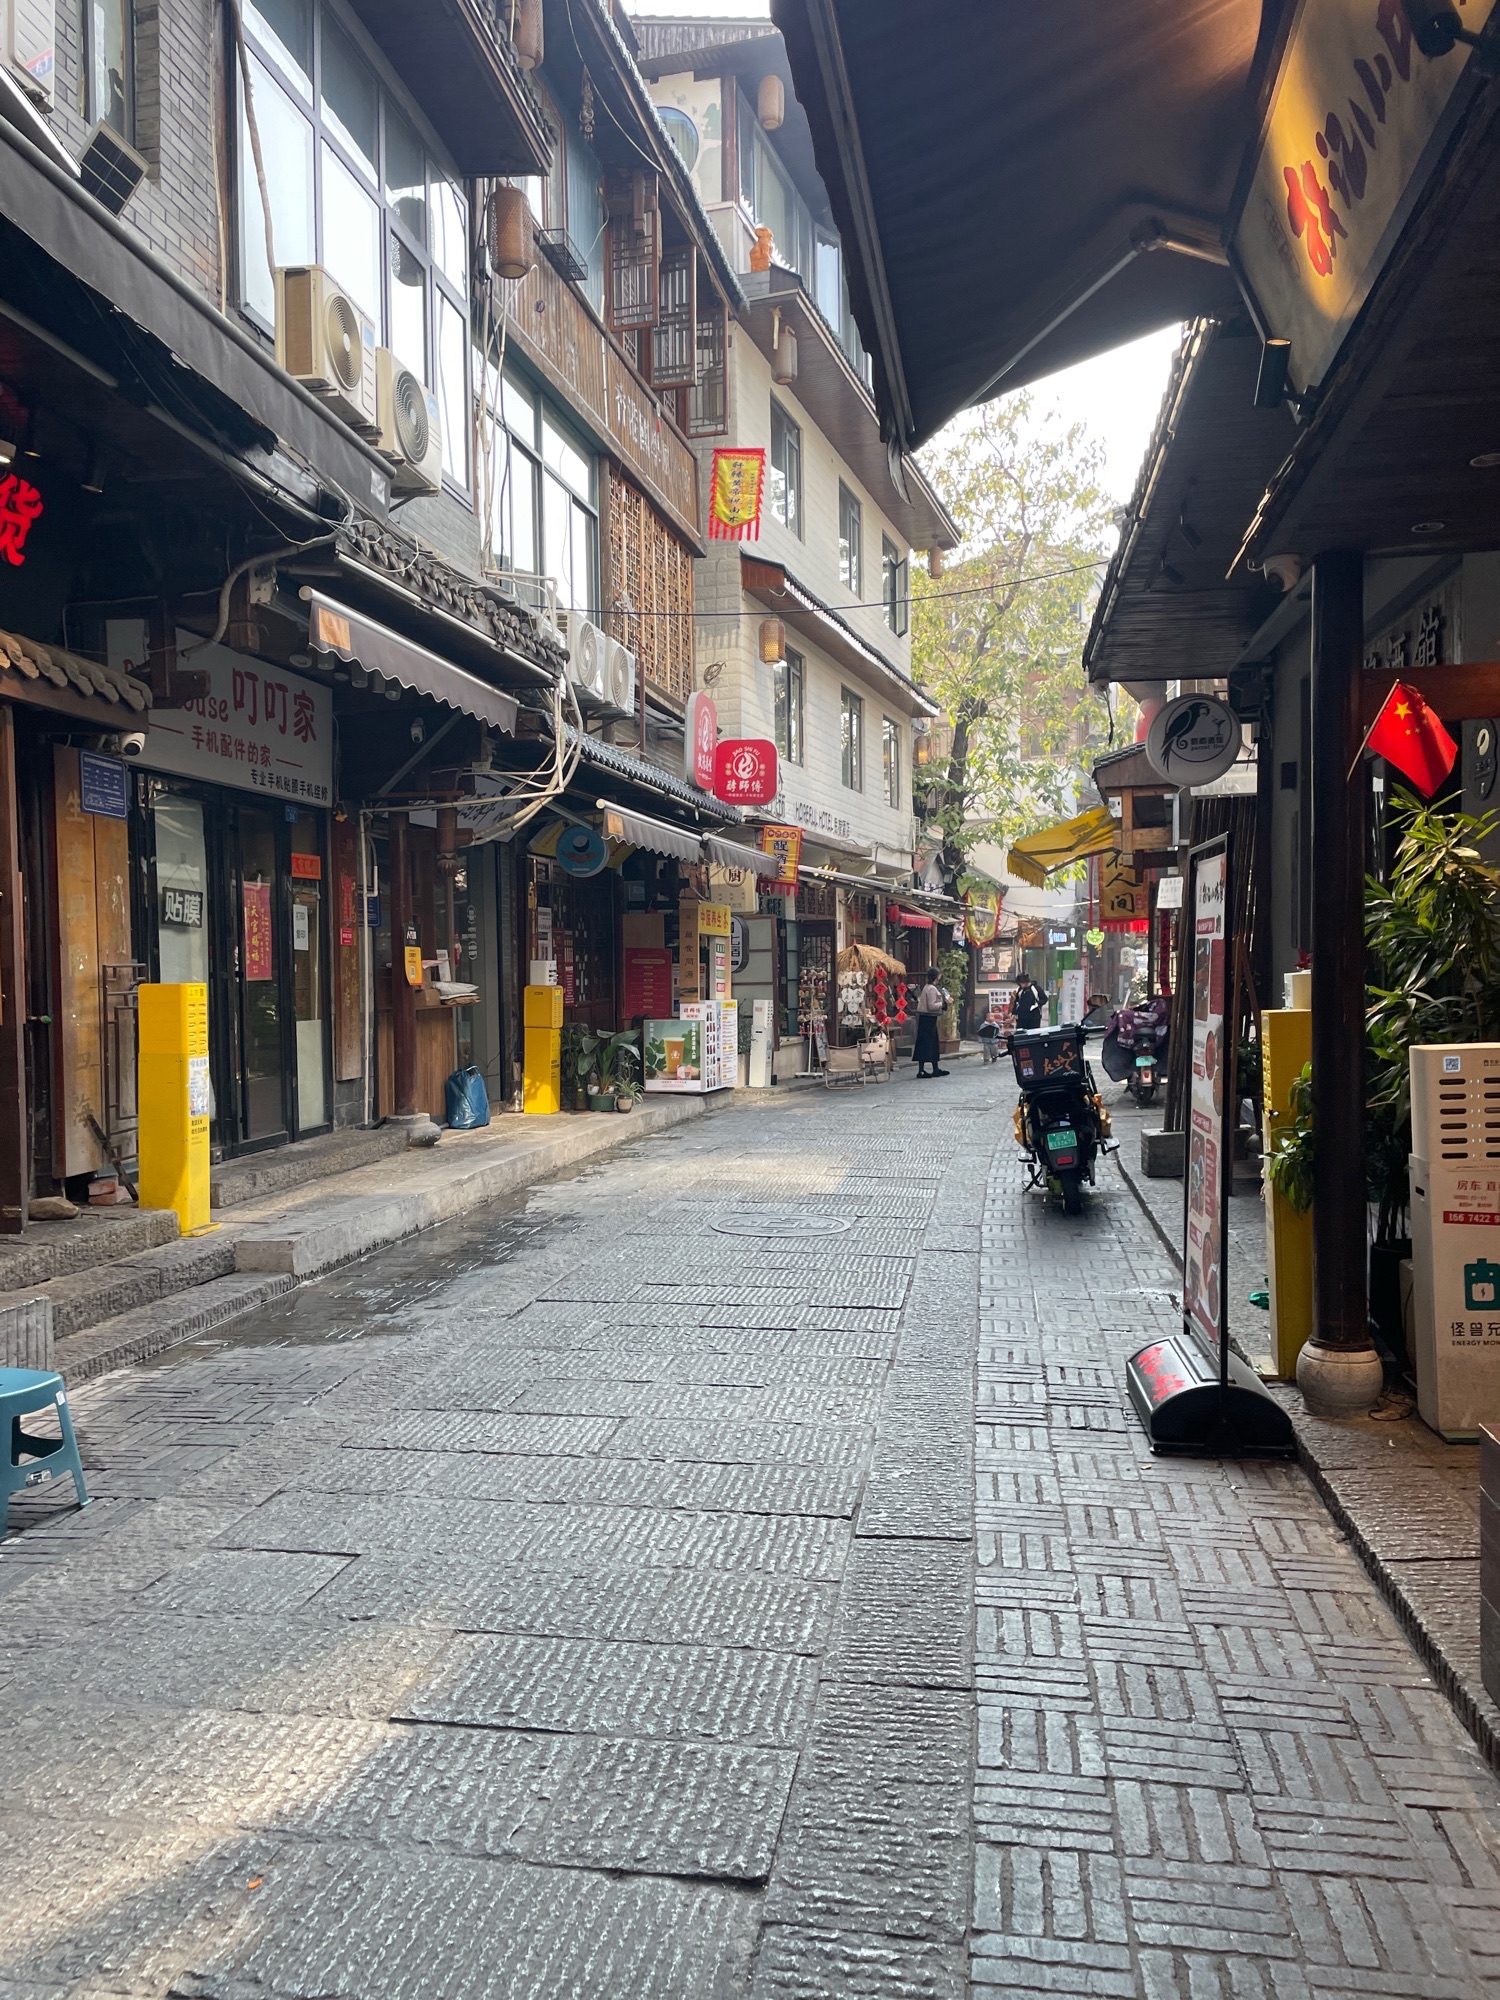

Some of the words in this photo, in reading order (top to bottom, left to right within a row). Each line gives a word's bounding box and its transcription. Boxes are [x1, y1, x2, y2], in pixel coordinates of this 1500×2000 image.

[232, 667, 317, 744] 叮叮家
[191, 725, 271, 768] 手机配件的家
[250, 768, 329, 802] 专业手机贴膜手机维修
[164, 890, 201, 926] 贴膜
[1456, 1180, 1482, 1191] 房东
[1448, 1212, 1465, 1222] 166
[1467, 1213, 1491, 1223] 7422
